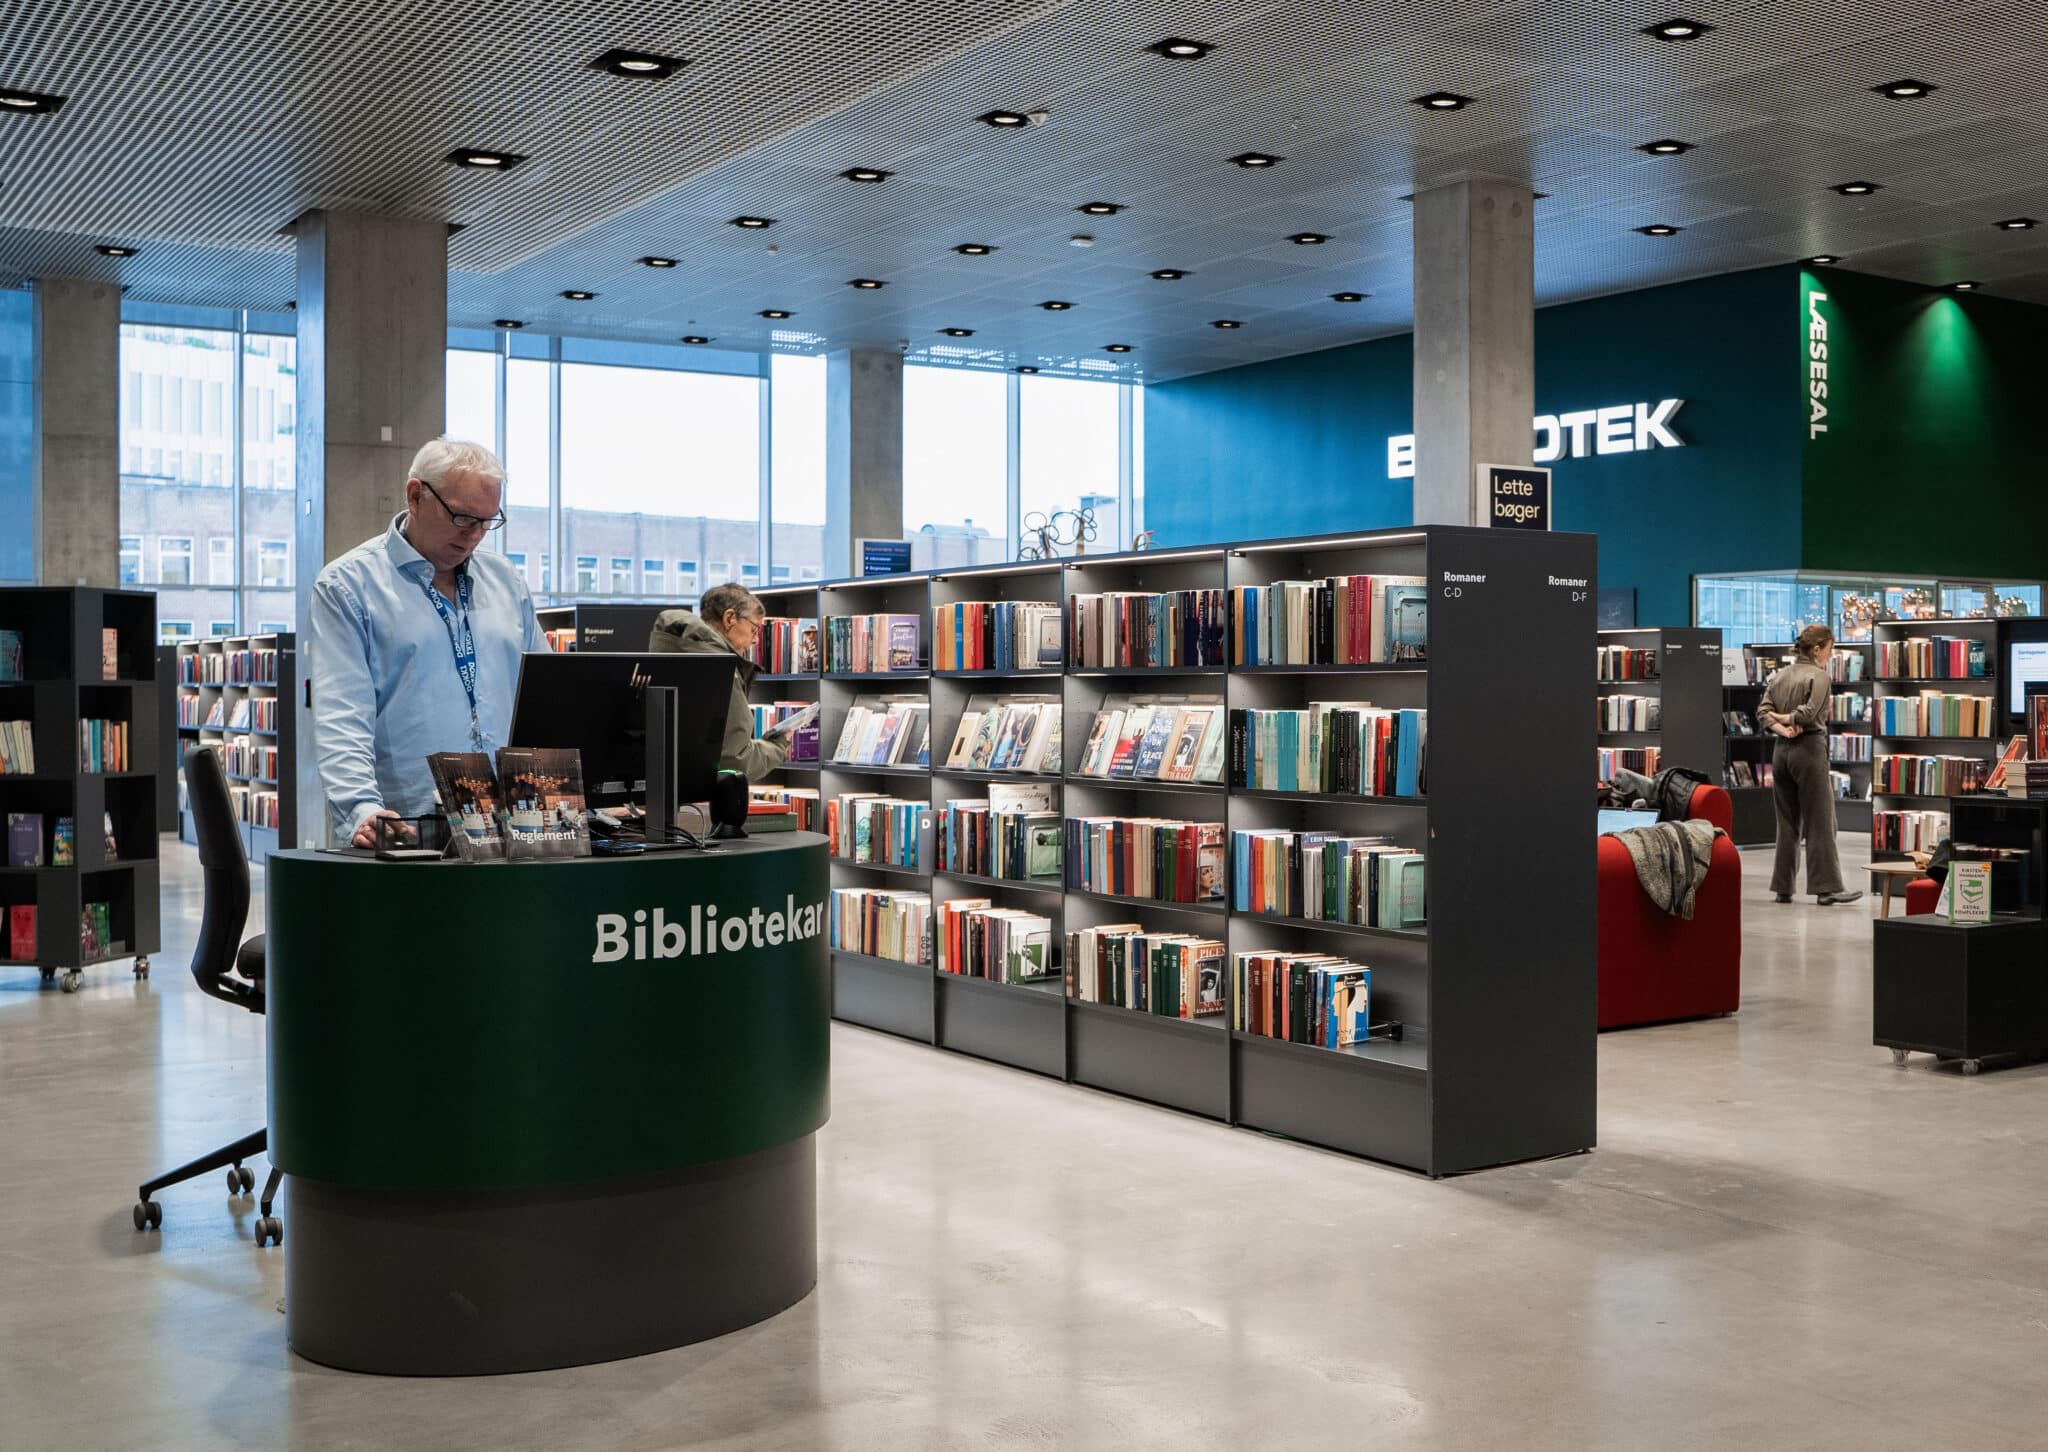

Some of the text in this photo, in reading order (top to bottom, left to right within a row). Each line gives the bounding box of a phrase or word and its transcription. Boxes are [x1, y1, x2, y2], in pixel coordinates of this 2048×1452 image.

[1808, 291, 1828, 440] LÆSESAL
[1387, 398, 1684, 479] BOTEK
[1495, 475, 1533, 496] Lette
[1495, 496, 1541, 523] bøger
[1444, 571, 1486, 583] Romaner
[1548, 575, 1588, 587] Romaner
[1444, 587, 1462, 598] C-D
[1572, 591, 1588, 602] D-F
[921, 819, 930, 829] D
[512, 829, 577, 844] Reglement
[592, 894, 823, 963] Bibliotekar
